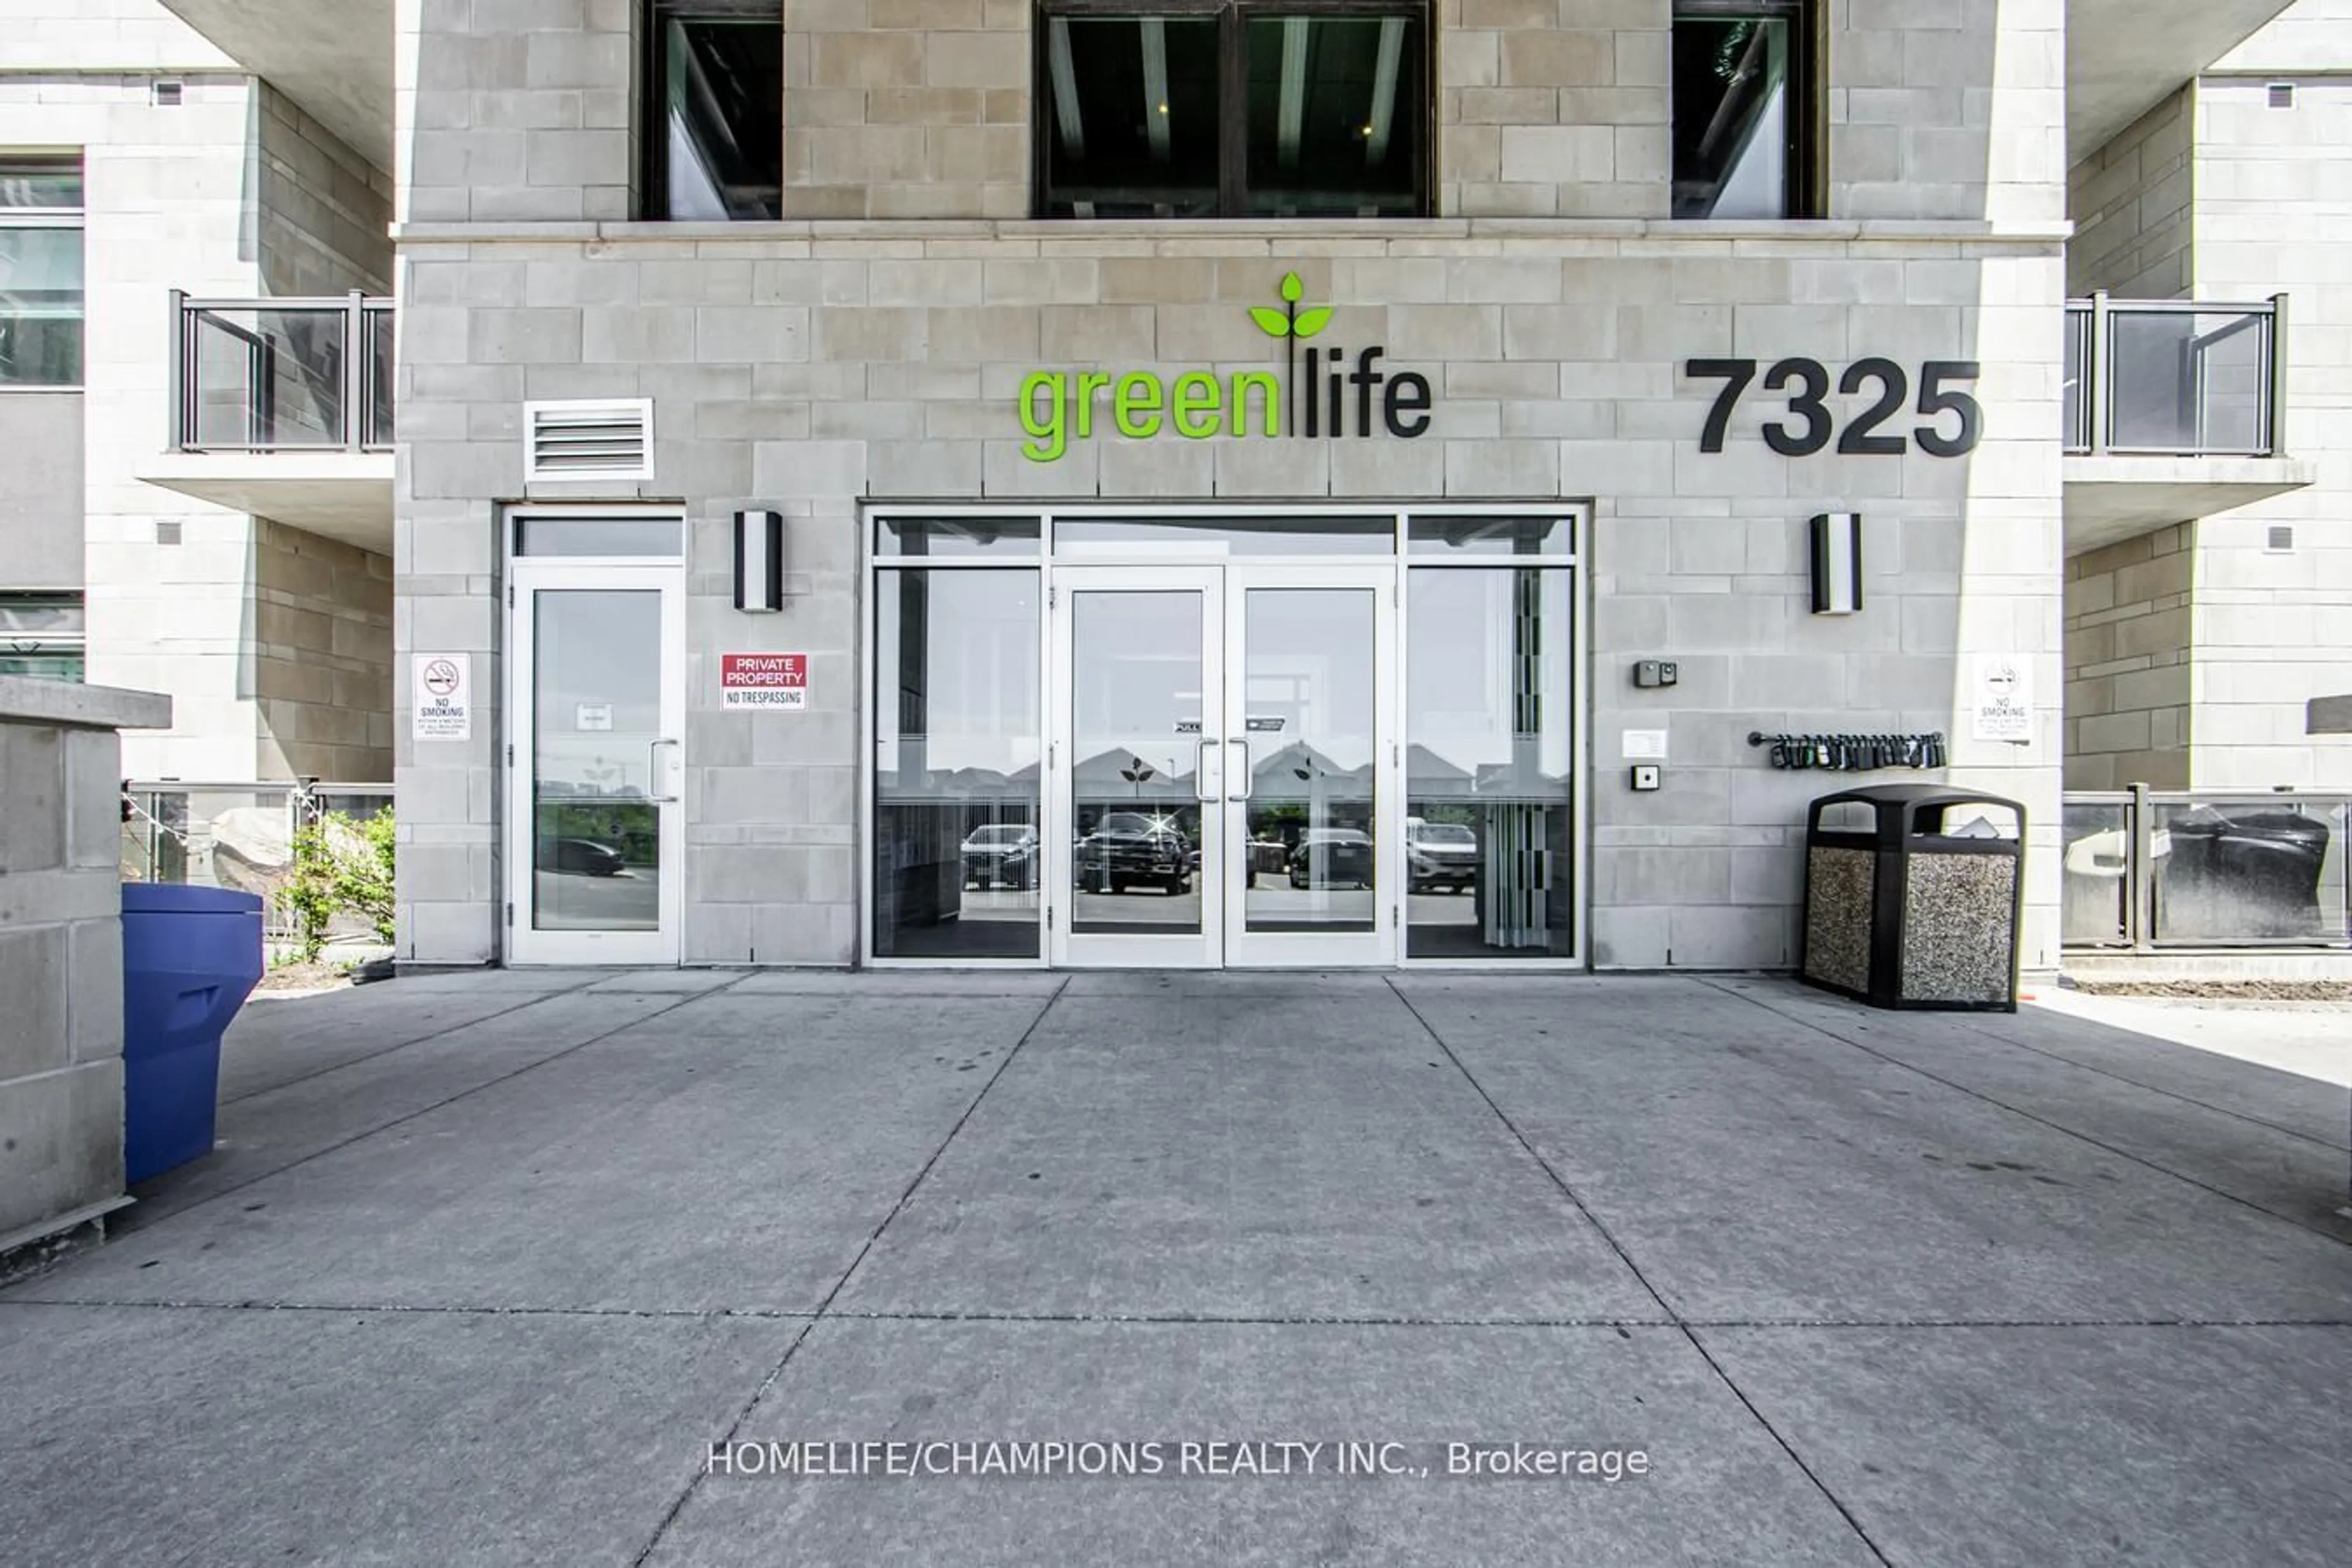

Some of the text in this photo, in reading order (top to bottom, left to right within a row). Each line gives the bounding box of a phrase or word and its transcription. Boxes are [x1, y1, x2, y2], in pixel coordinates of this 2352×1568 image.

[1686, 357, 1985, 458] 7325
[1019, 370, 1280, 462] green
[736, 658, 794, 671] PRIVATE
[726, 672, 802, 684] PROPERTY
[435, 697, 449, 707] NO
[726, 691, 801, 704] NO TRESPASSING
[1996, 697, 2010, 708] NO
[421, 707, 464, 717] SMOKING
[1981, 706, 2026, 717] SMOKING
